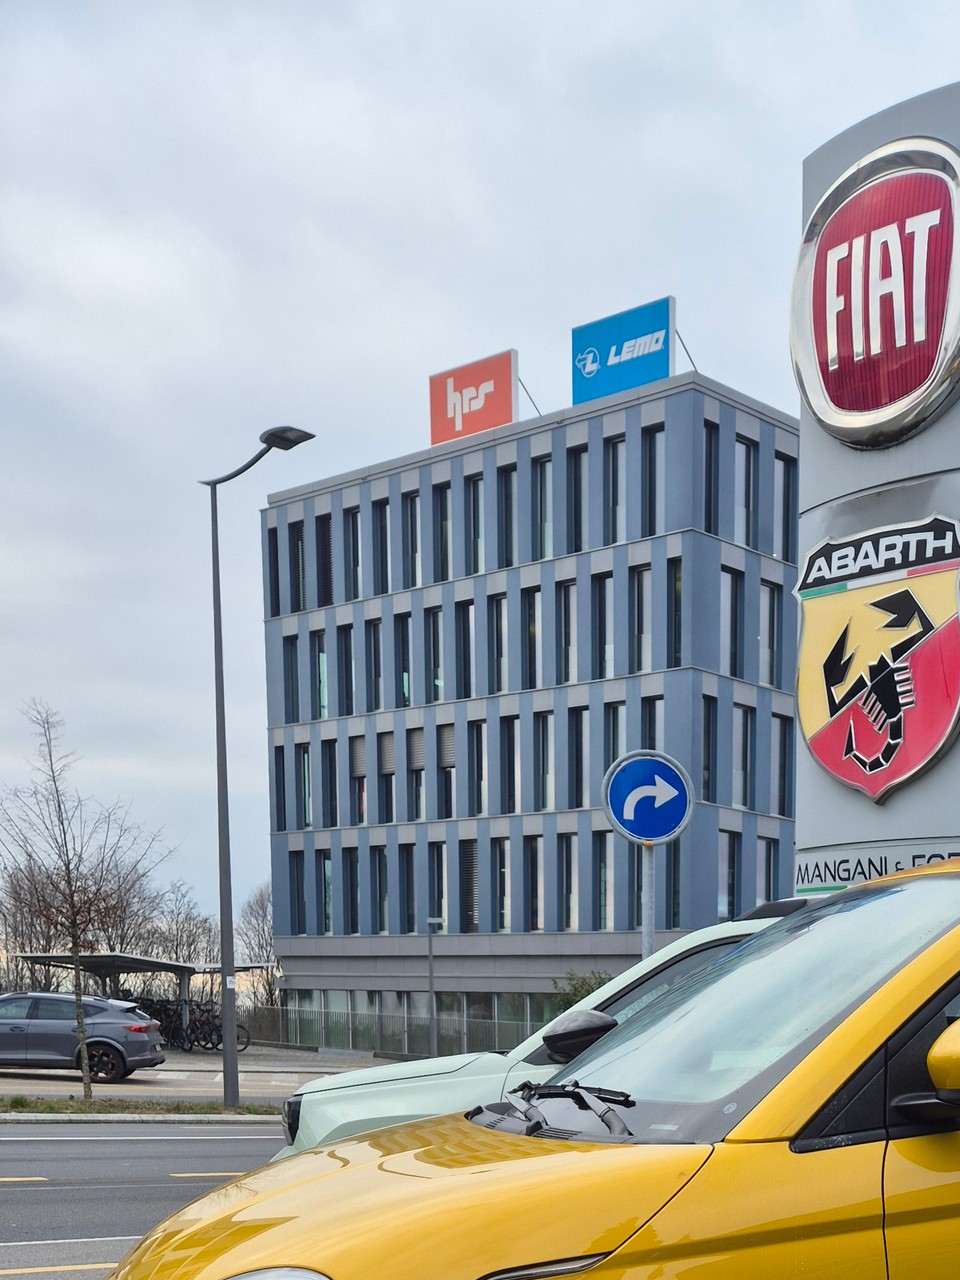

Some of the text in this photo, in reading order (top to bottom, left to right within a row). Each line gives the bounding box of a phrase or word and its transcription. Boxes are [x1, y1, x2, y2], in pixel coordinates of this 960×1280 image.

[826, 208, 942, 372] FIAT
[607, 329, 666, 367] LEMO
[447, 377, 494, 431] hrs
[806, 531, 953, 583] ABARTH
[796, 855, 888, 886] MANGANI
